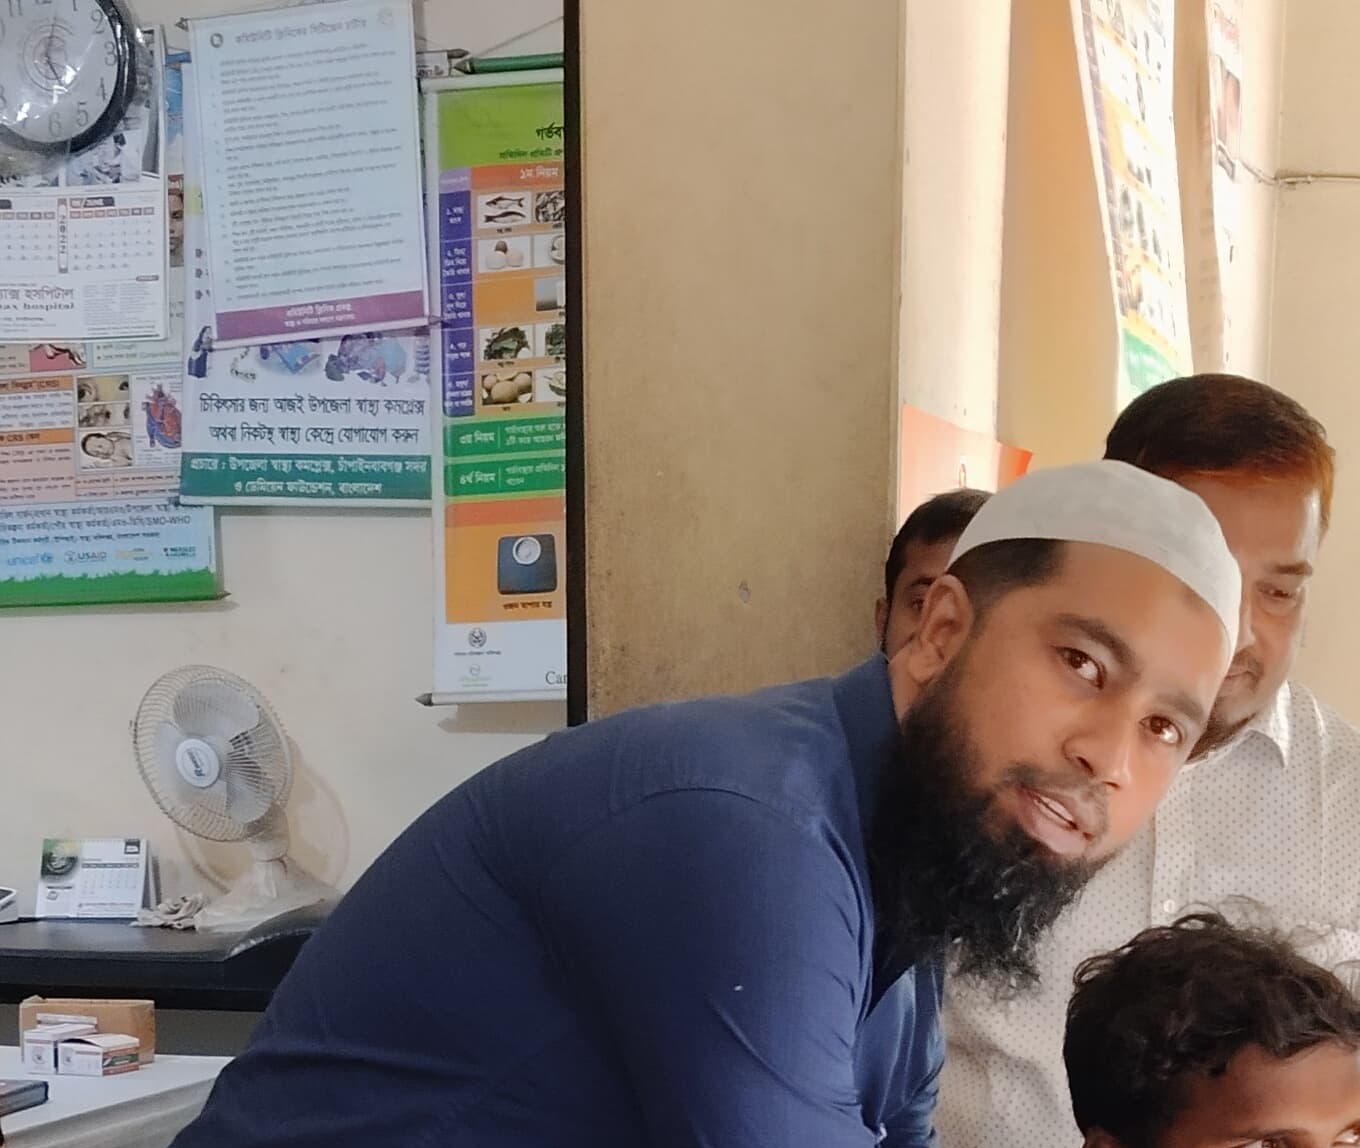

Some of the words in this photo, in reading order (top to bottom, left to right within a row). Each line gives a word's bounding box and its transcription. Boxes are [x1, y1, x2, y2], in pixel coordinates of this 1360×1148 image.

[91, 9, 105, 34] 2
[104, 41, 118, 66] 3
[95, 77, 108, 101] 4
[48, 112, 62, 138] 6
[76, 102, 89, 127] 5
[24, 285, 74, 301] হসপিটাল
[23, 301, 75, 311] hospital
[200, 392, 246, 413] চিকিৎসার
[248, 398, 271, 414] জন্য
[273, 393, 305, 414] আজই
[307, 393, 351, 414] উপজেলা
[355, 398, 380, 417] স্বাস্থ্য
[208, 426, 237, 441] অথবা
[240, 421, 275, 446] নিকটস্থ
[278, 426, 302, 445] স্বাস্থ্য
[305, 427, 335, 445] কেন্দ্রে
[337, 426, 388, 443] যোগাযোগ
[390, 427, 420, 444] করুন
